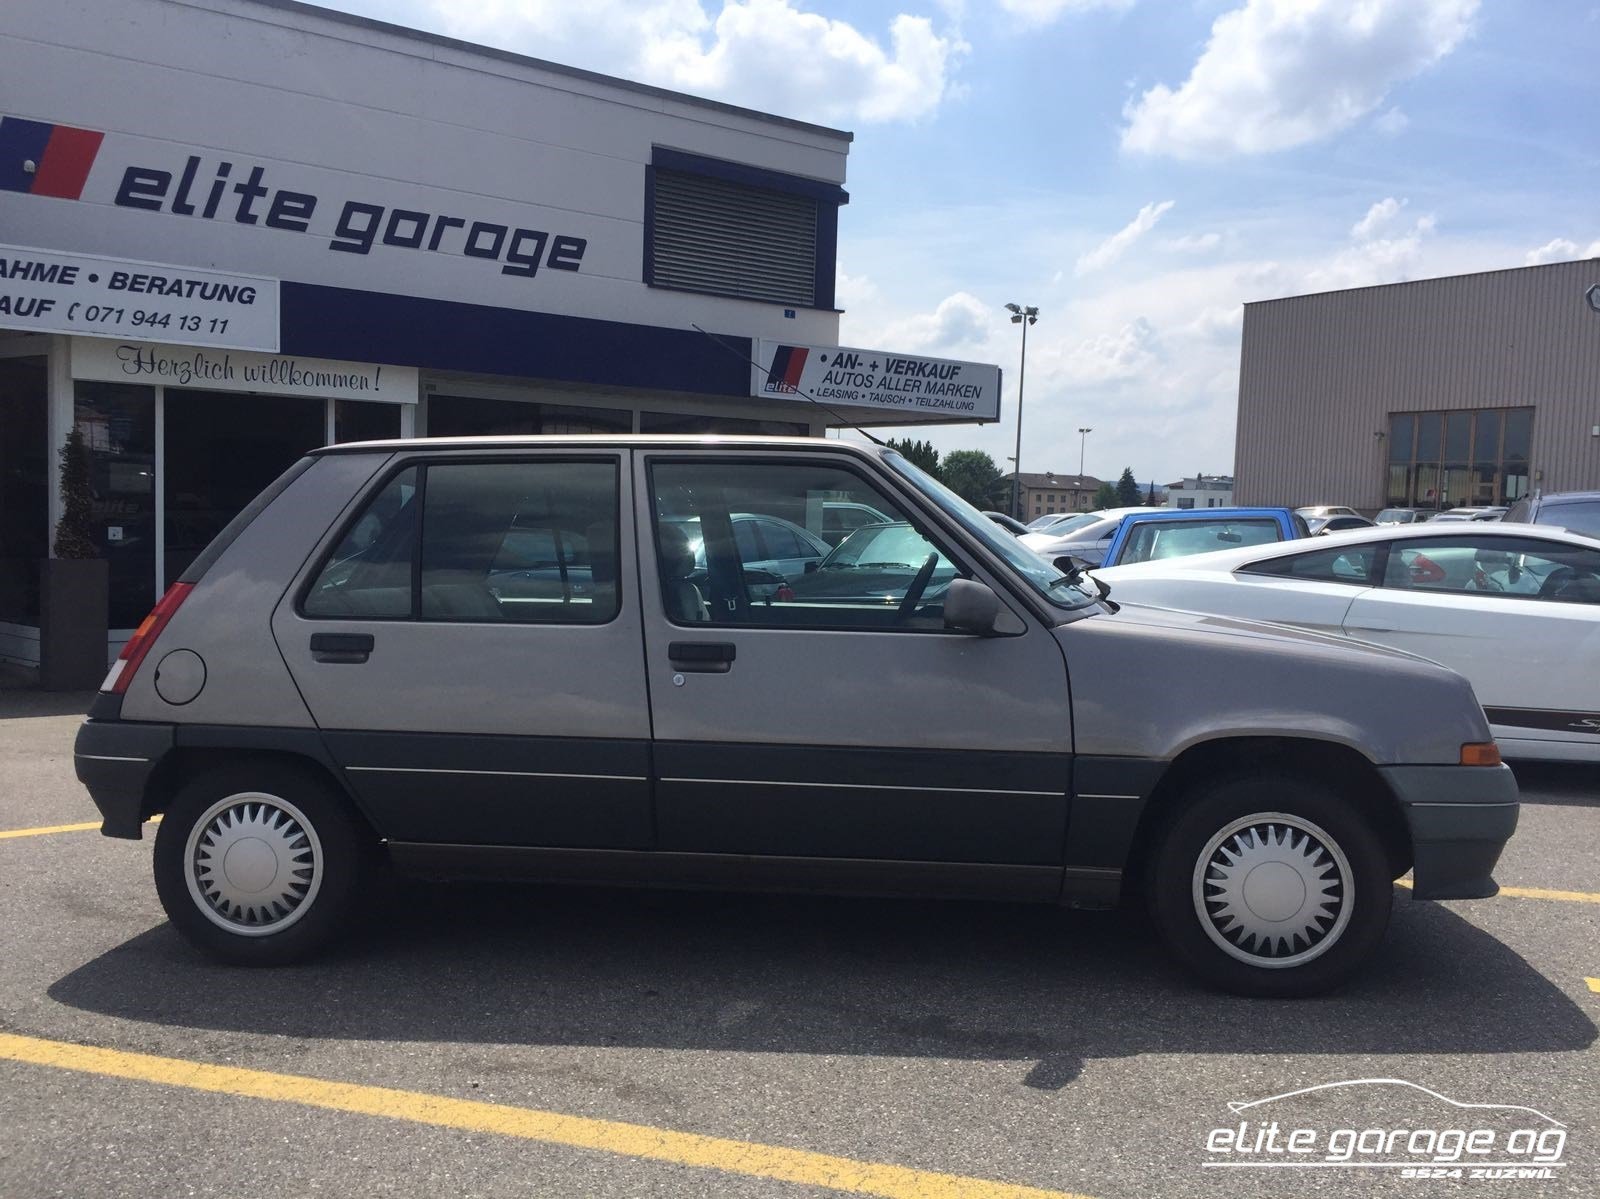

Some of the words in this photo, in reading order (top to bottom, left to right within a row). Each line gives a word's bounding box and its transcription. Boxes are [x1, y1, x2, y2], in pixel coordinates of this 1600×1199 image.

[114, 155, 318, 233] elite
[329, 200, 587, 278] garage
[0, 259, 80, 285] AHME
[108, 271, 257, 305] BERATUNG
[0, 295, 56, 318] AUF
[85, 305, 125, 324] 071
[131, 310, 170, 329] 944
[179, 316, 201, 331] 13
[209, 318, 229, 334] 11
[116, 345, 233, 384] Herzlich
[831, 352, 863, 370] AN-
[885, 358, 961, 381] VERKAUF
[765, 381, 797, 394] elite
[816, 387, 859, 401] LEASING
[869, 392, 906, 405] TAUSCH
[915, 396, 975, 411] TEILZAHLUNG
[822, 370, 873, 389] AUTOS
[877, 375, 921, 393] ALLER
[924, 381, 983, 399] MARKEN
